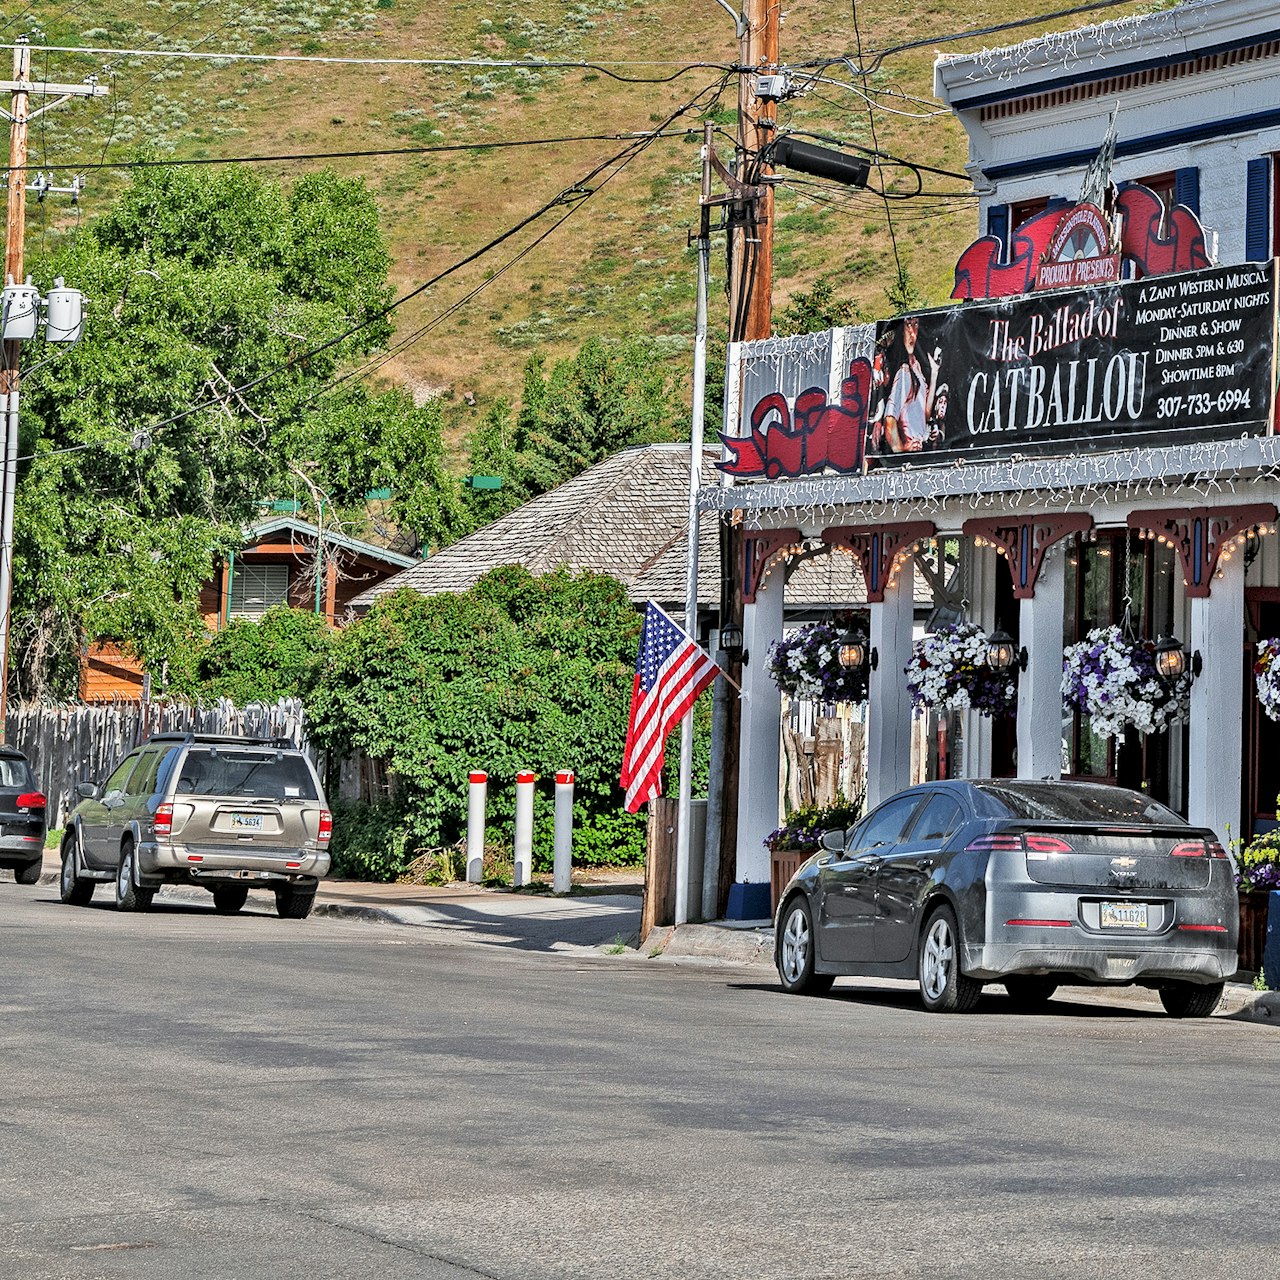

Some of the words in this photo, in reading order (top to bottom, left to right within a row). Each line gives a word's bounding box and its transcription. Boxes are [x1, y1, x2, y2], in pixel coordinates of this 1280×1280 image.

[1040, 263, 1075, 286] PROUDLY
[1138, 289, 1147, 303] A
[1149, 285, 1177, 302] ZANY
[1179, 277, 1223, 297] WESTERN
[1226, 271, 1269, 290] MUSICAL
[1135, 298, 1232, 325] MONDAY-SATURDAY
[1234, 292, 1270, 310] NIGHTS
[990, 320, 1025, 361] The
[1029, 298, 1095, 357] Ballad
[1097, 297, 1124, 339] of
[1160, 325, 1198, 343] DINNER
[1200, 322, 1208, 336] &
[1210, 319, 1242, 335] SHOW
[1155, 347, 1193, 364] DINNER
[1195, 344, 1215, 359] 5PM
[1216, 342, 1225, 355] &
[1227, 339, 1245, 354] 6:30
[1161, 365, 1214, 385] SHOWTIME
[1216, 364, 1235, 376] 8PM
[1156, 388, 1251, 419] 307-733-6994
[1110, 869, 1138, 877] VOLT
[1118, 910, 1146, 922] 11628
